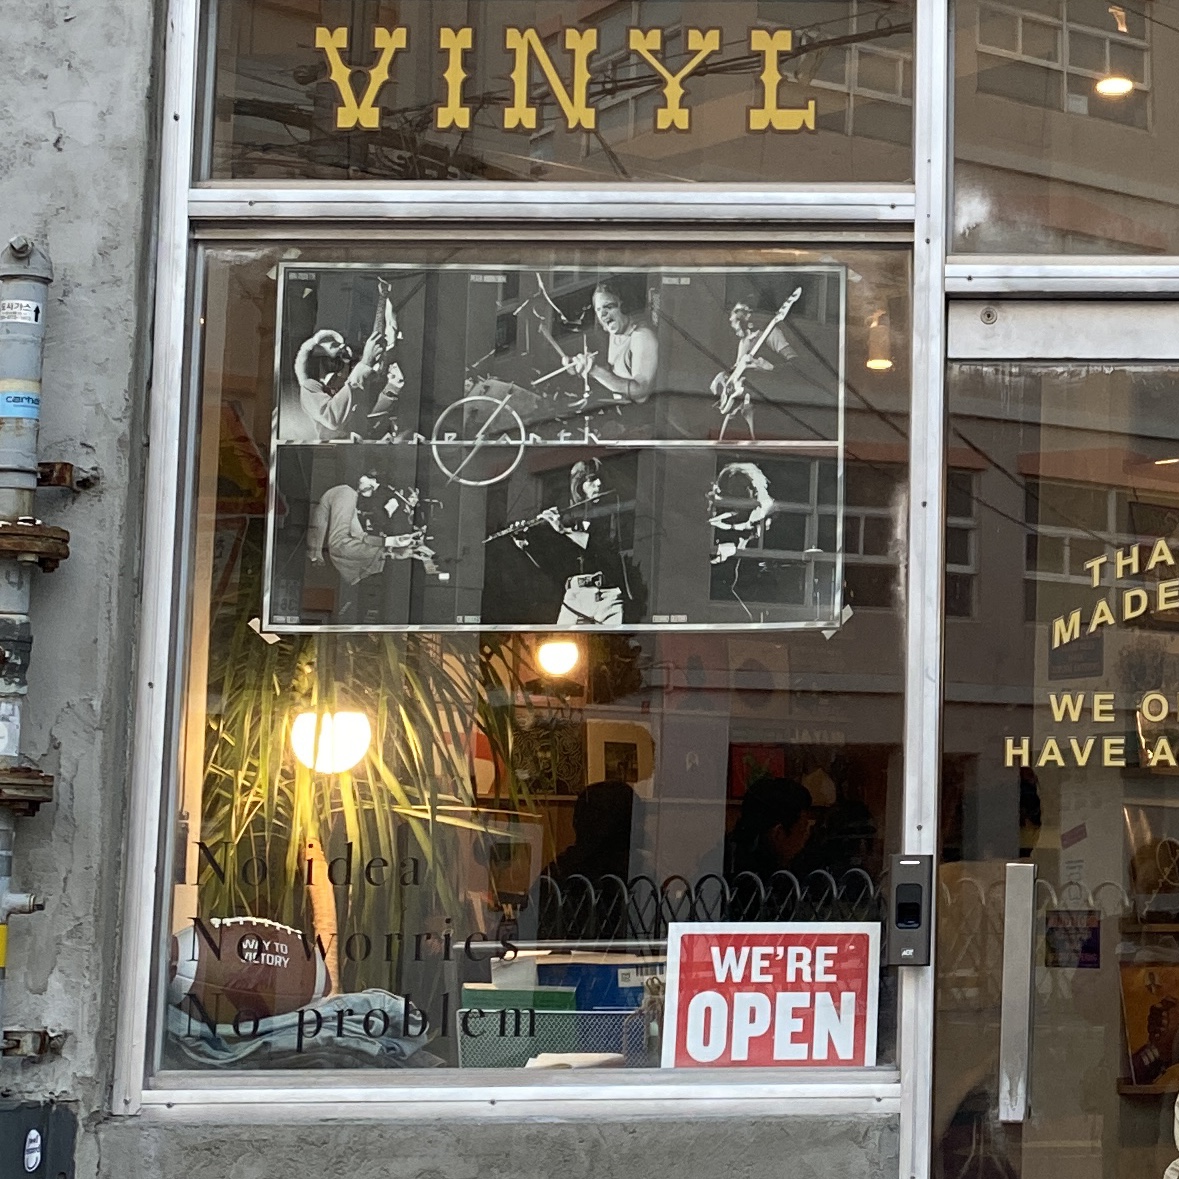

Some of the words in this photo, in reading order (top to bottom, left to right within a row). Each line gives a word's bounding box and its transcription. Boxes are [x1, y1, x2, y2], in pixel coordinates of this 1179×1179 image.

[313, 26, 817, 132] VINYL
[1049, 692, 1117, 723] WE
[1004, 736, 1127, 768] HAVE
[1149, 736, 1177, 768] A
[191, 841, 268, 887] No
[304, 842, 421, 887] idea
[187, 917, 267, 962] No
[301, 918, 519, 963] worries
[273, 942, 289, 954] TO
[710, 946, 838, 983] WE'RE
[185, 993, 261, 1039] No
[296, 993, 536, 1053] problem
[686, 990, 856, 1063] OPEN
